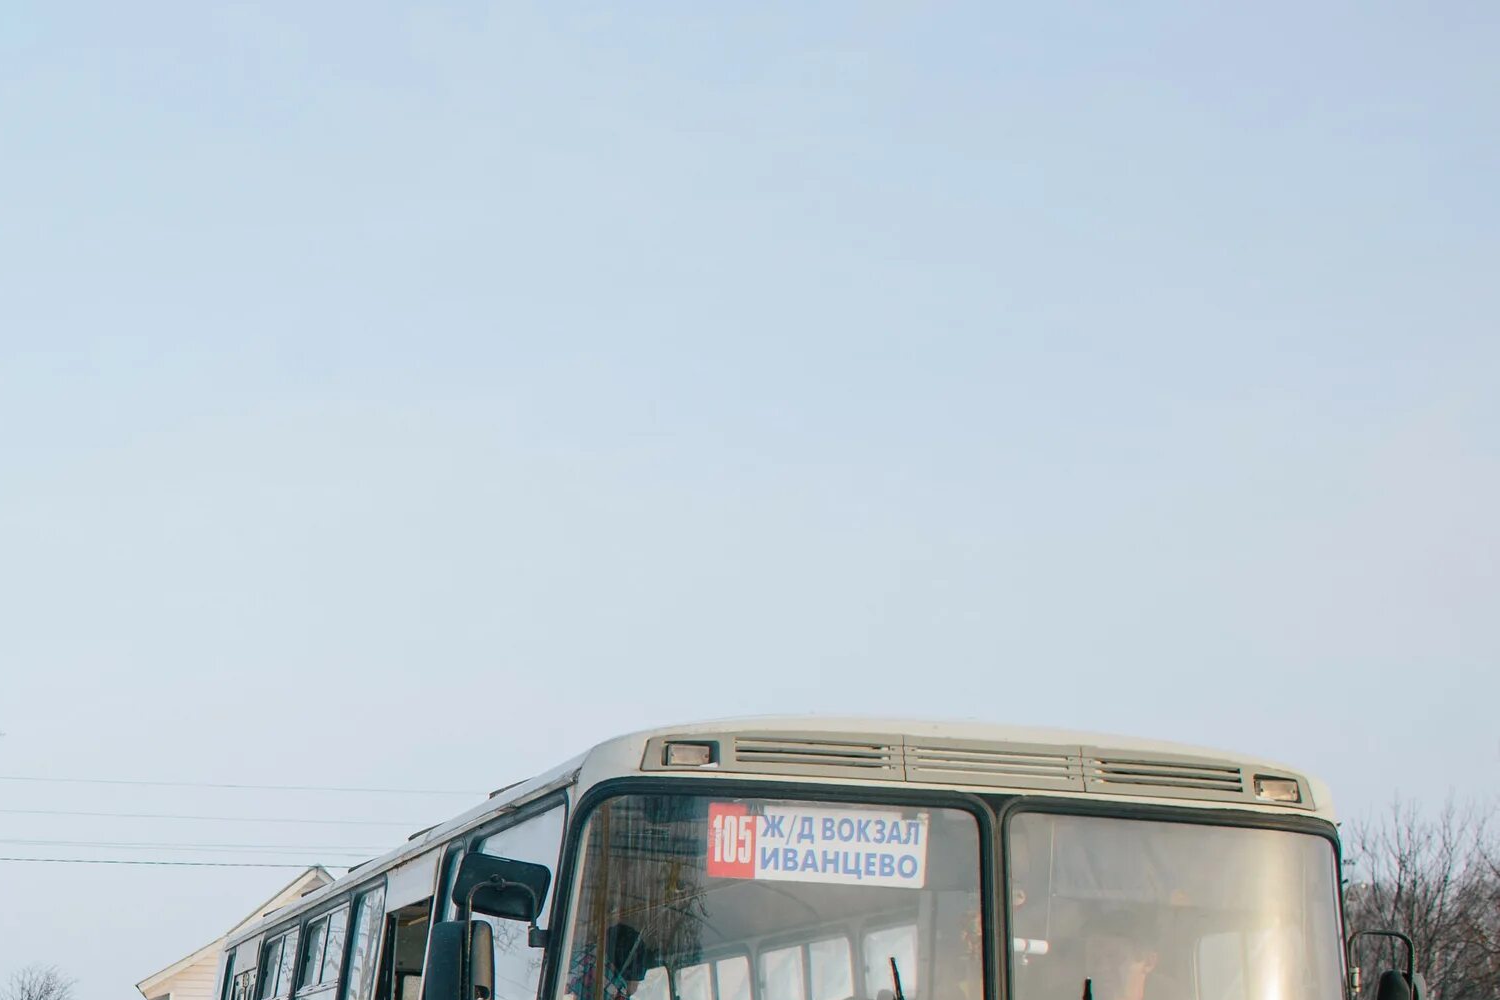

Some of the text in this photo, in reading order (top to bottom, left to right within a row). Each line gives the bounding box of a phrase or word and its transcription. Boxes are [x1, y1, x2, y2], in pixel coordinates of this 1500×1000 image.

[712, 814, 753, 864] 105
[761, 814, 920, 845] Ж/Д ВОКЗАЛ
[760, 847, 919, 880] ИВАНЦЕВО
